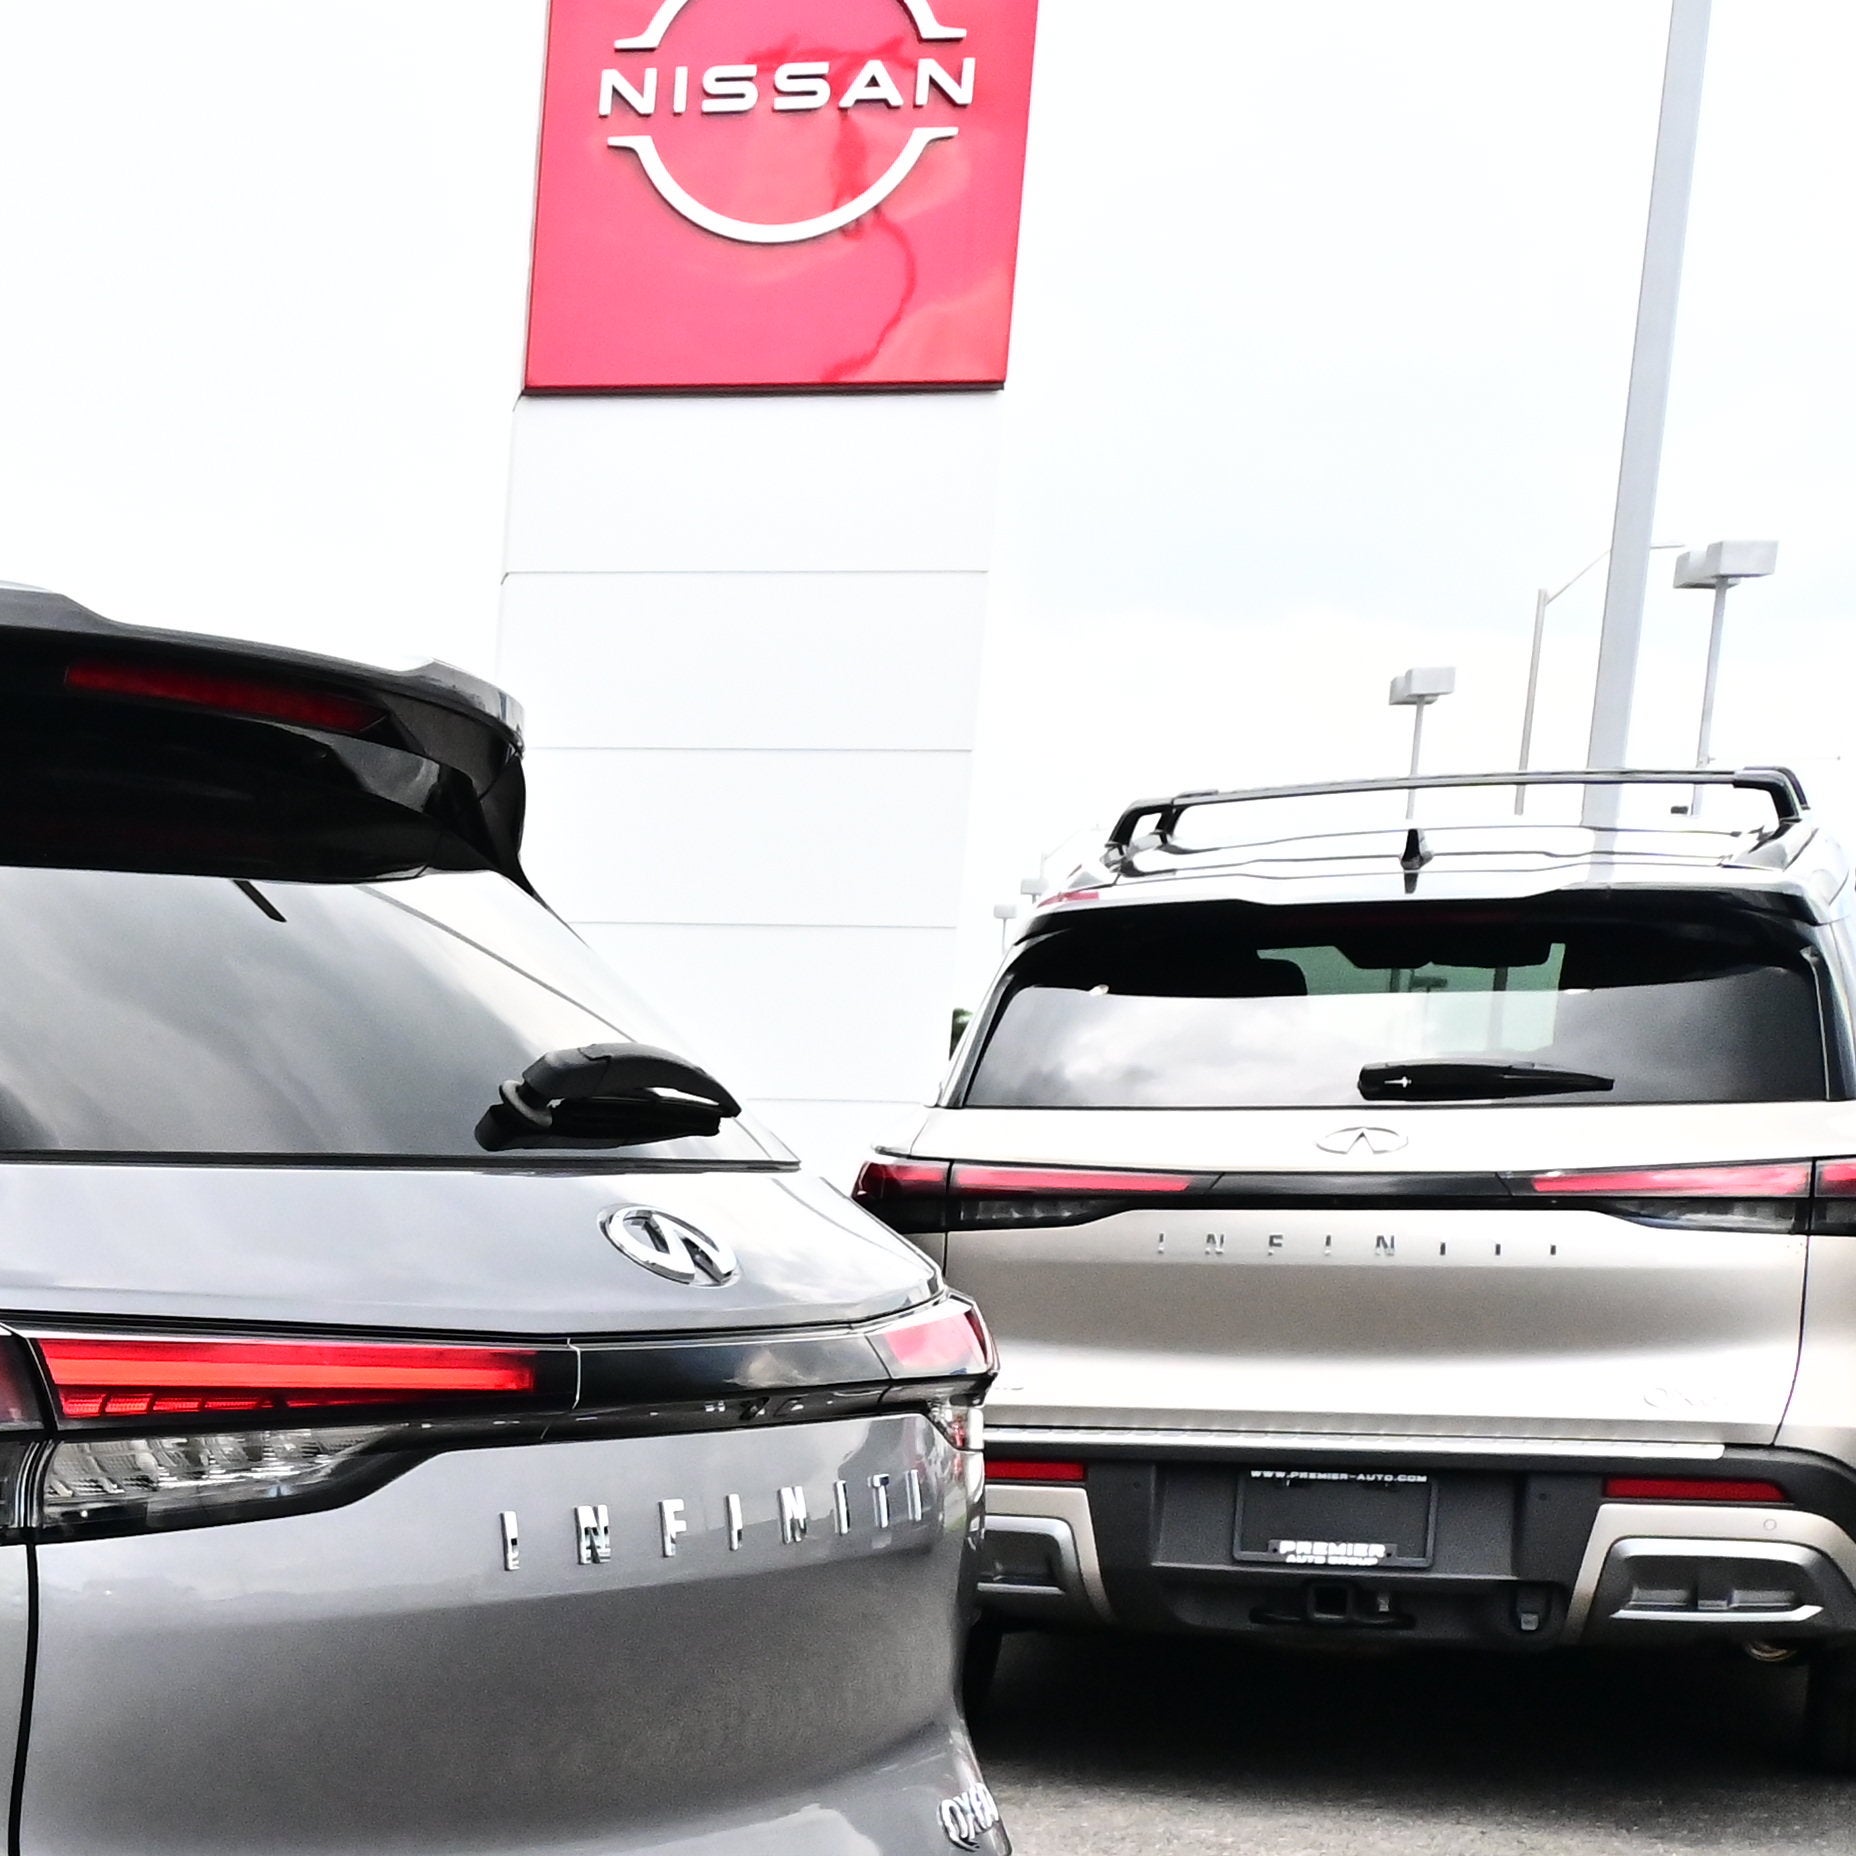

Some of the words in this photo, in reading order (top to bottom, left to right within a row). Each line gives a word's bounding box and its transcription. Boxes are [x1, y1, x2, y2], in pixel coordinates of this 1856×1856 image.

[598, 57, 976, 117] NISSAN
[1250, 1470, 1428, 1483] WWW.PREMIER-AUTO.COM
[499, 1468, 924, 1571] INFINITI
[1279, 1540, 1386, 1558] PREMIER
[1285, 1554, 1327, 1565] AUTO
